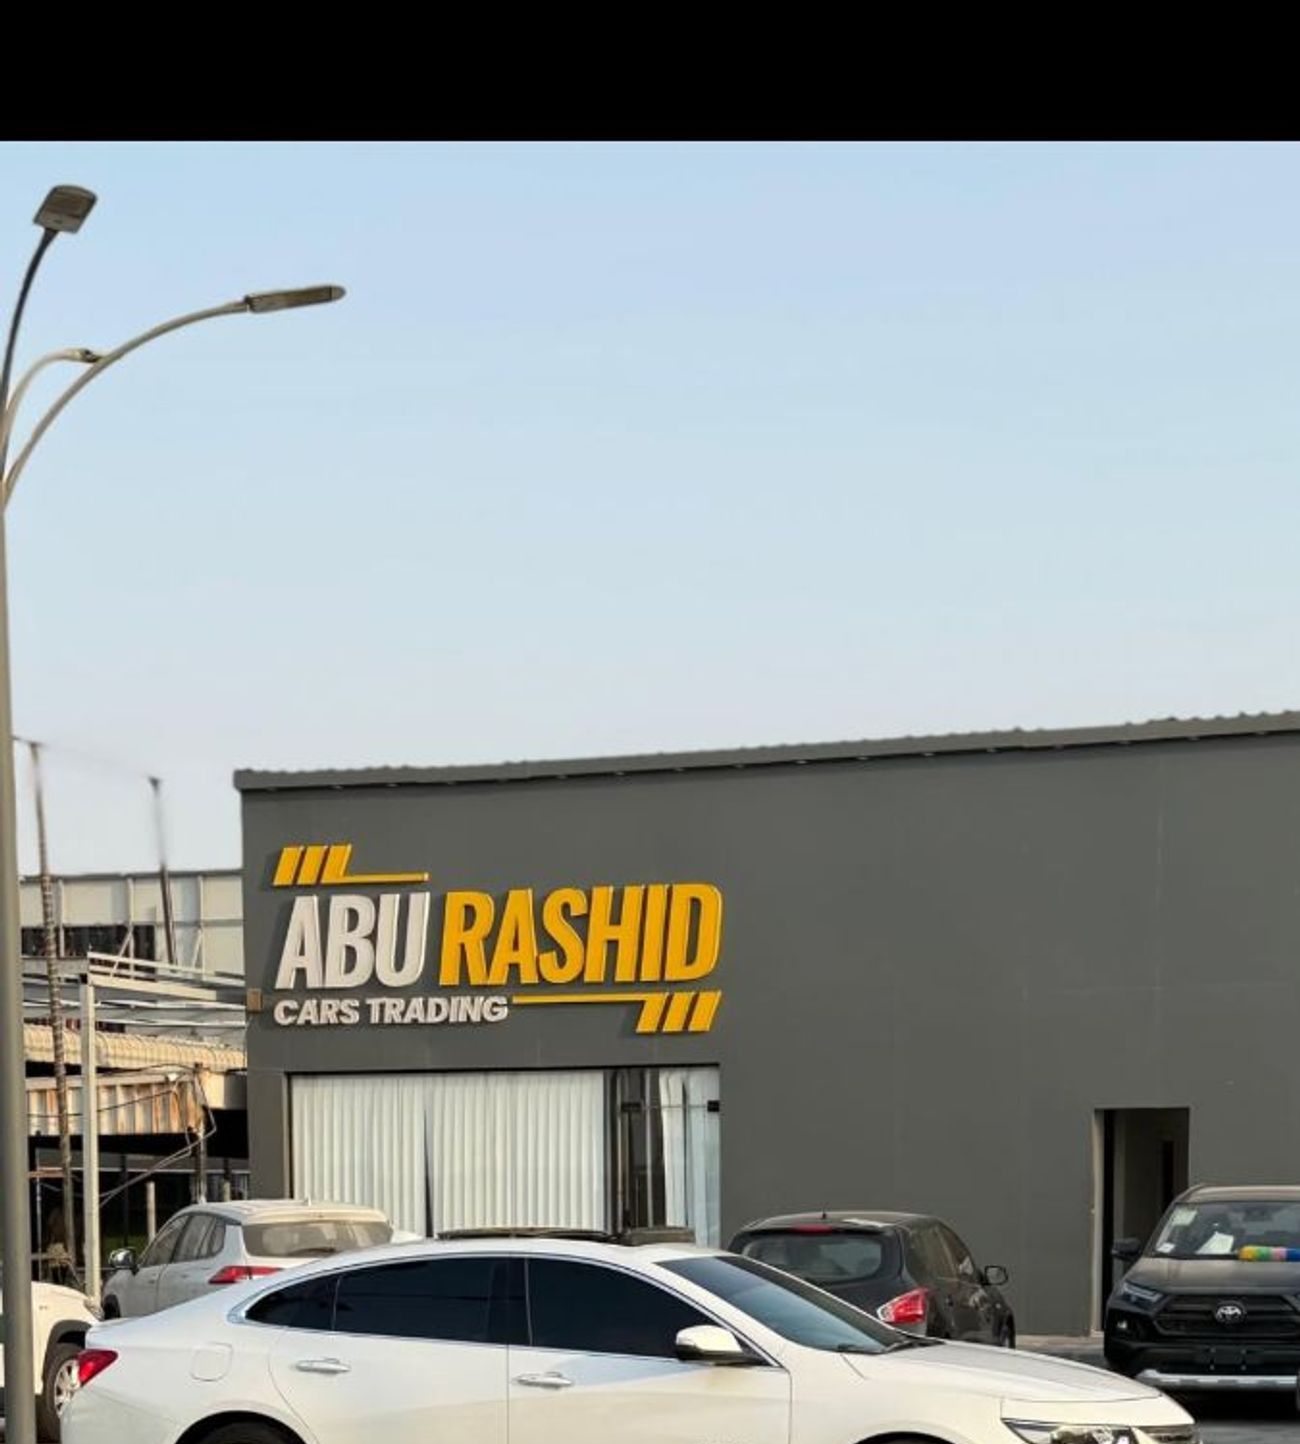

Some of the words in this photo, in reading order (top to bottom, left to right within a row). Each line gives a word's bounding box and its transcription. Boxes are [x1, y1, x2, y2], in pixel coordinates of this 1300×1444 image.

[274, 892, 430, 989] ABU
[439, 883, 722, 986] RASHID
[273, 998, 360, 1025] CARS
[366, 995, 509, 1024] TRADING
